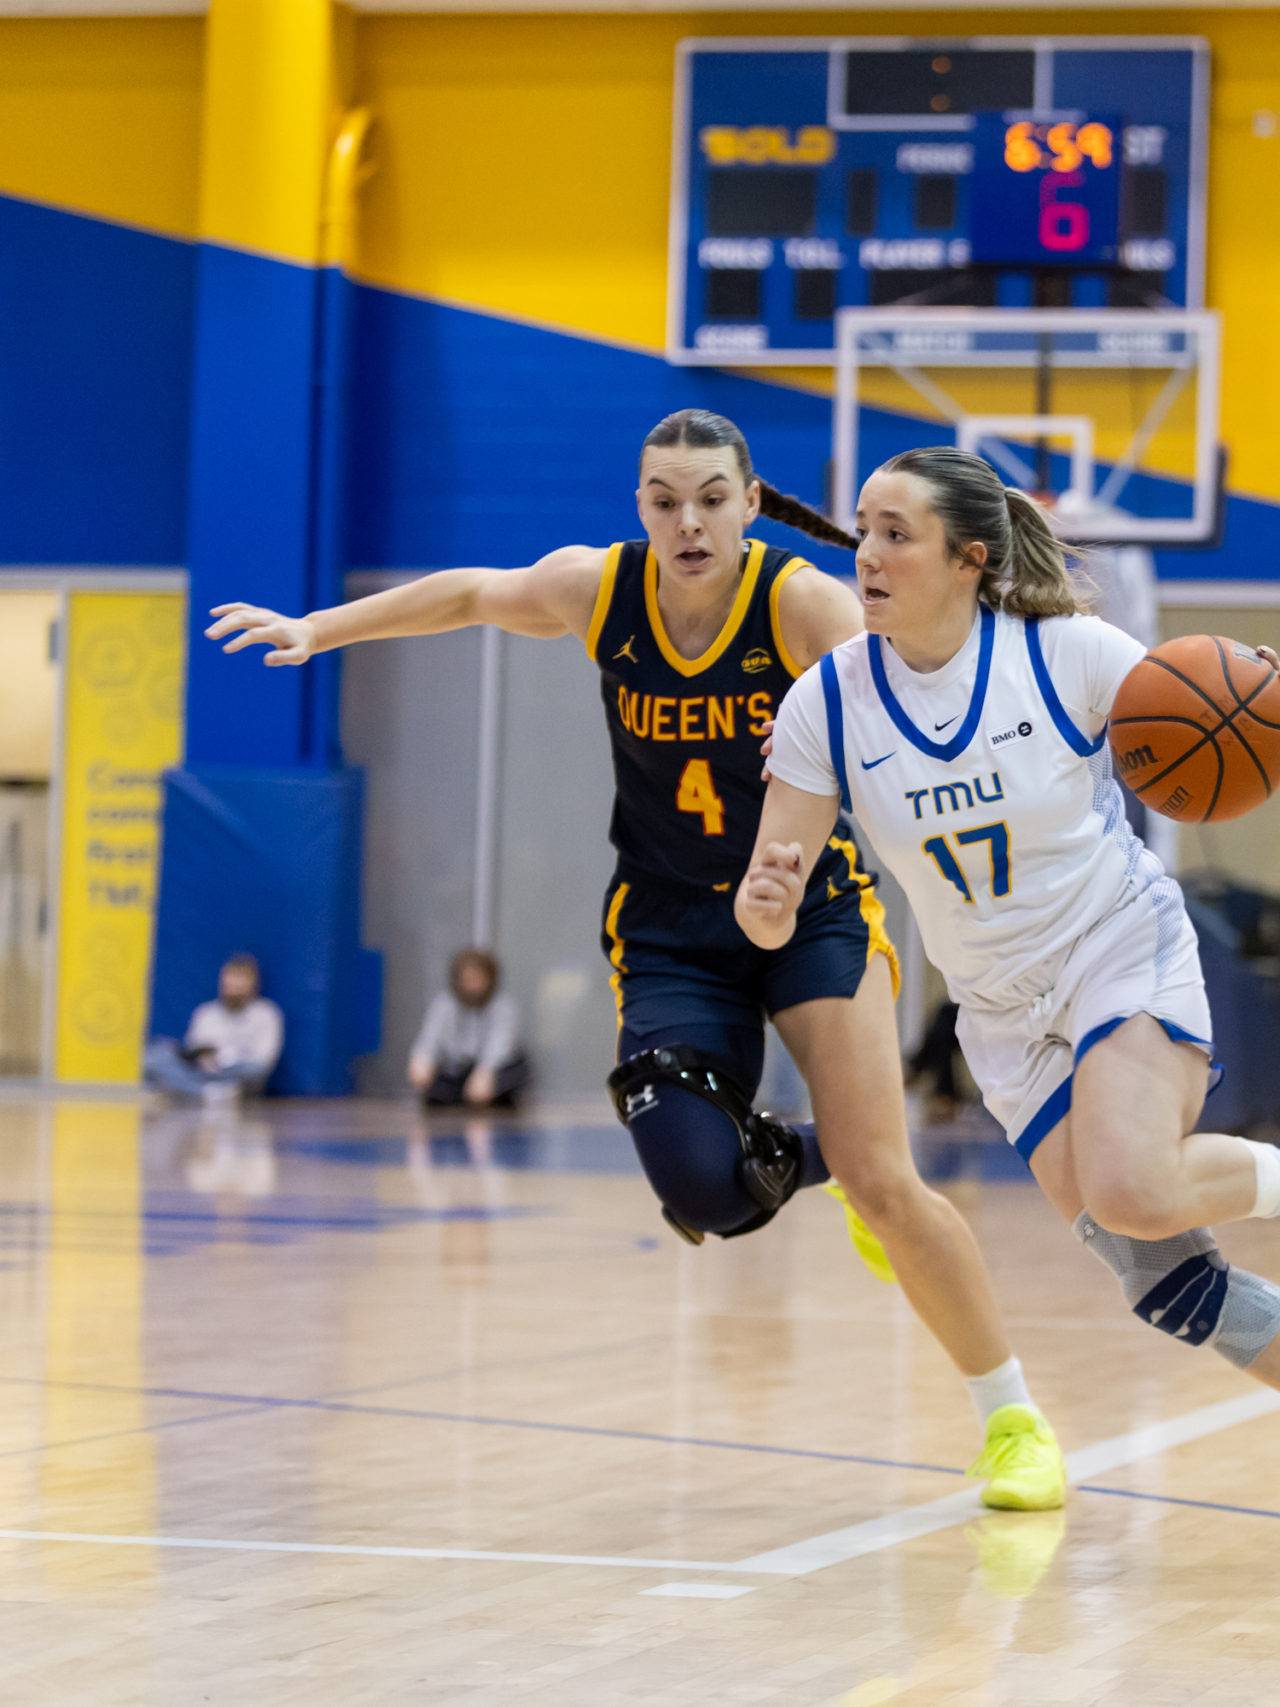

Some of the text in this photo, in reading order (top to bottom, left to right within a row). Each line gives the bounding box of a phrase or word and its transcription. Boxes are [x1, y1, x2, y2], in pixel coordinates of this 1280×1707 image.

[1004, 122, 1112, 172] 6:59
[618, 684, 774, 742] QUEEN'S
[991, 730, 1016, 745] BMO
[675, 758, 725, 836] 4
[903, 771, 1005, 820] TMU
[921, 818, 1012, 905] 17
